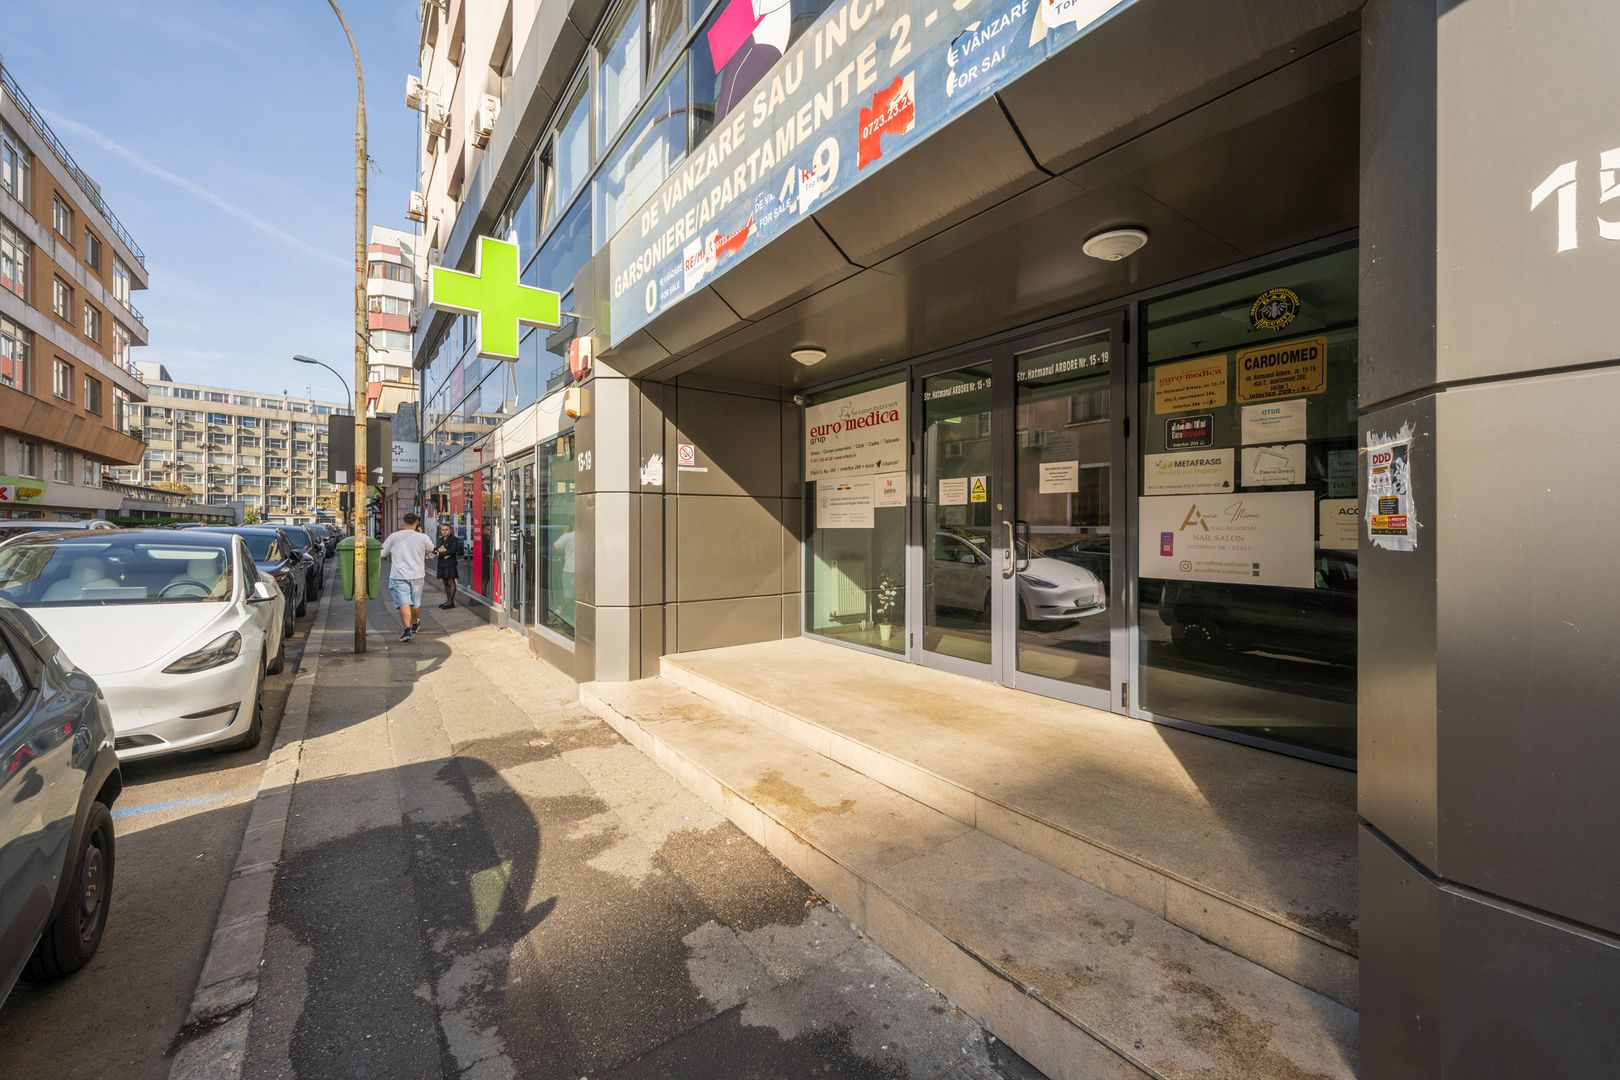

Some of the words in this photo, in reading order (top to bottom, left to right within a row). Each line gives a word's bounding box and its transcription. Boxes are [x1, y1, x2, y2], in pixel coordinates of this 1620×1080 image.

[641, 210, 659, 237] DE
[662, 112, 745, 214] VANZARE
[752, 49, 804, 128] SAU
[814, 0, 887, 70] INC
[614, 41, 877, 298] GARSONIERE/APARTAMENTE
[889, 14, 912, 68] 2
[759, 213, 773, 229] FOR
[773, 198, 792, 219] SALE
[1016, 370, 1027, 382] Str.
[1028, 363, 1054, 379] Hatmanul
[1055, 358, 1078, 374] ARBORE
[1079, 356, 1088, 368] Nr.
[1089, 354, 1096, 366] 15
[1101, 351, 1109, 363] 19
[1244, 346, 1318, 371] CARDIOMED
[1160, 375, 1182, 384] euro
[1185, 368, 1221, 379] medica
[924, 391, 932, 401] Str.
[932, 387, 951, 400] Hatmanul
[953, 383, 969, 395] ARBORE
[977, 380, 983, 390] 15
[985, 377, 992, 388] 19
[810, 421, 842, 438] euro
[845, 409, 899, 432] medica
[1261, 408, 1281, 416] OTDR
[810, 435, 826, 445] grup
[577, 450, 592, 472] 15-19
[1174, 458, 1222, 467] METAFRASIS
[1372, 452, 1391, 464] DDD
[1215, 534, 1244, 542] SALON
